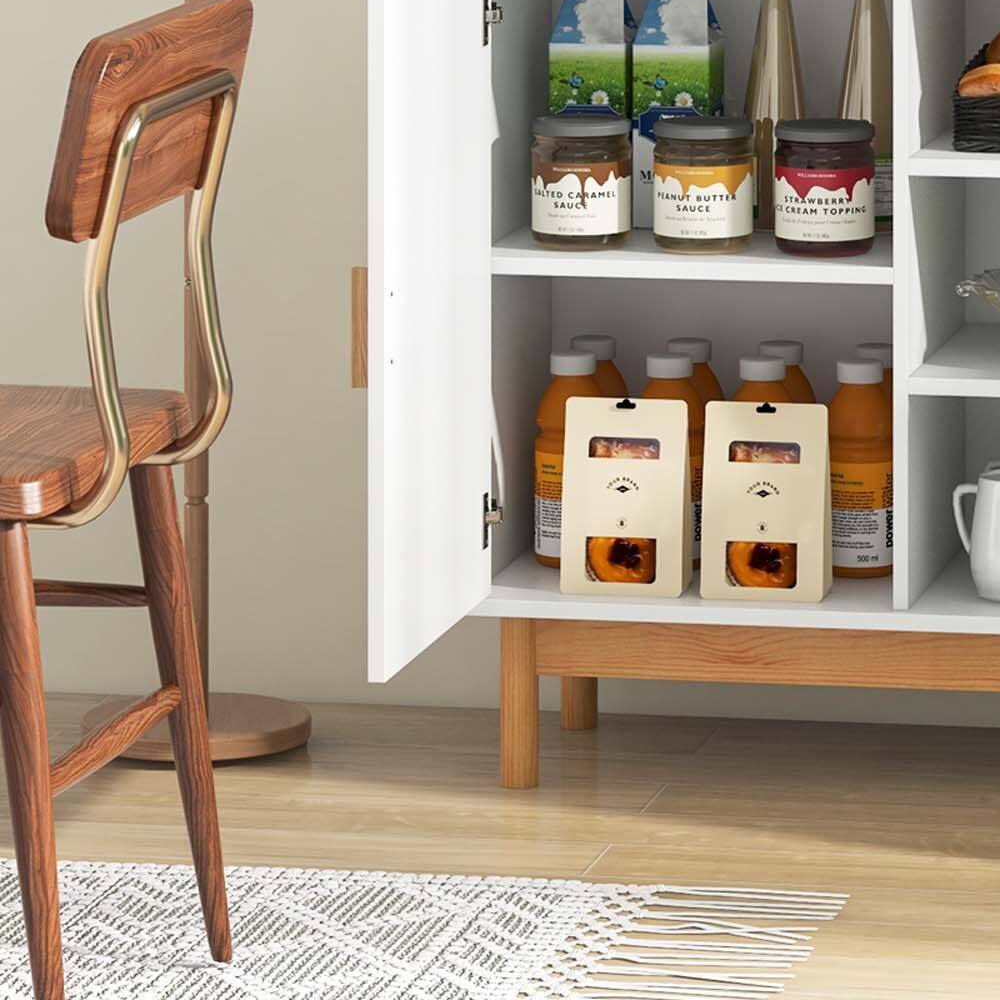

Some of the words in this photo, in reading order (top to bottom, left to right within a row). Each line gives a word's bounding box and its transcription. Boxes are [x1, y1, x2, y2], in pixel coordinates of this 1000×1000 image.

[567, 190, 616, 200] CARAMEL
[657, 191, 691, 202] PEANUT
[696, 194, 737, 202] BUTTER
[553, 201, 588, 210] SAUCE
[784, 195, 850, 206] STRAWBERRY
[676, 204, 711, 213] SAUCE
[785, 205, 818, 215] CREAM
[823, 205, 867, 216] TOPPING
[857, 554, 870, 562] 500
[871, 554, 879, 562] ml
